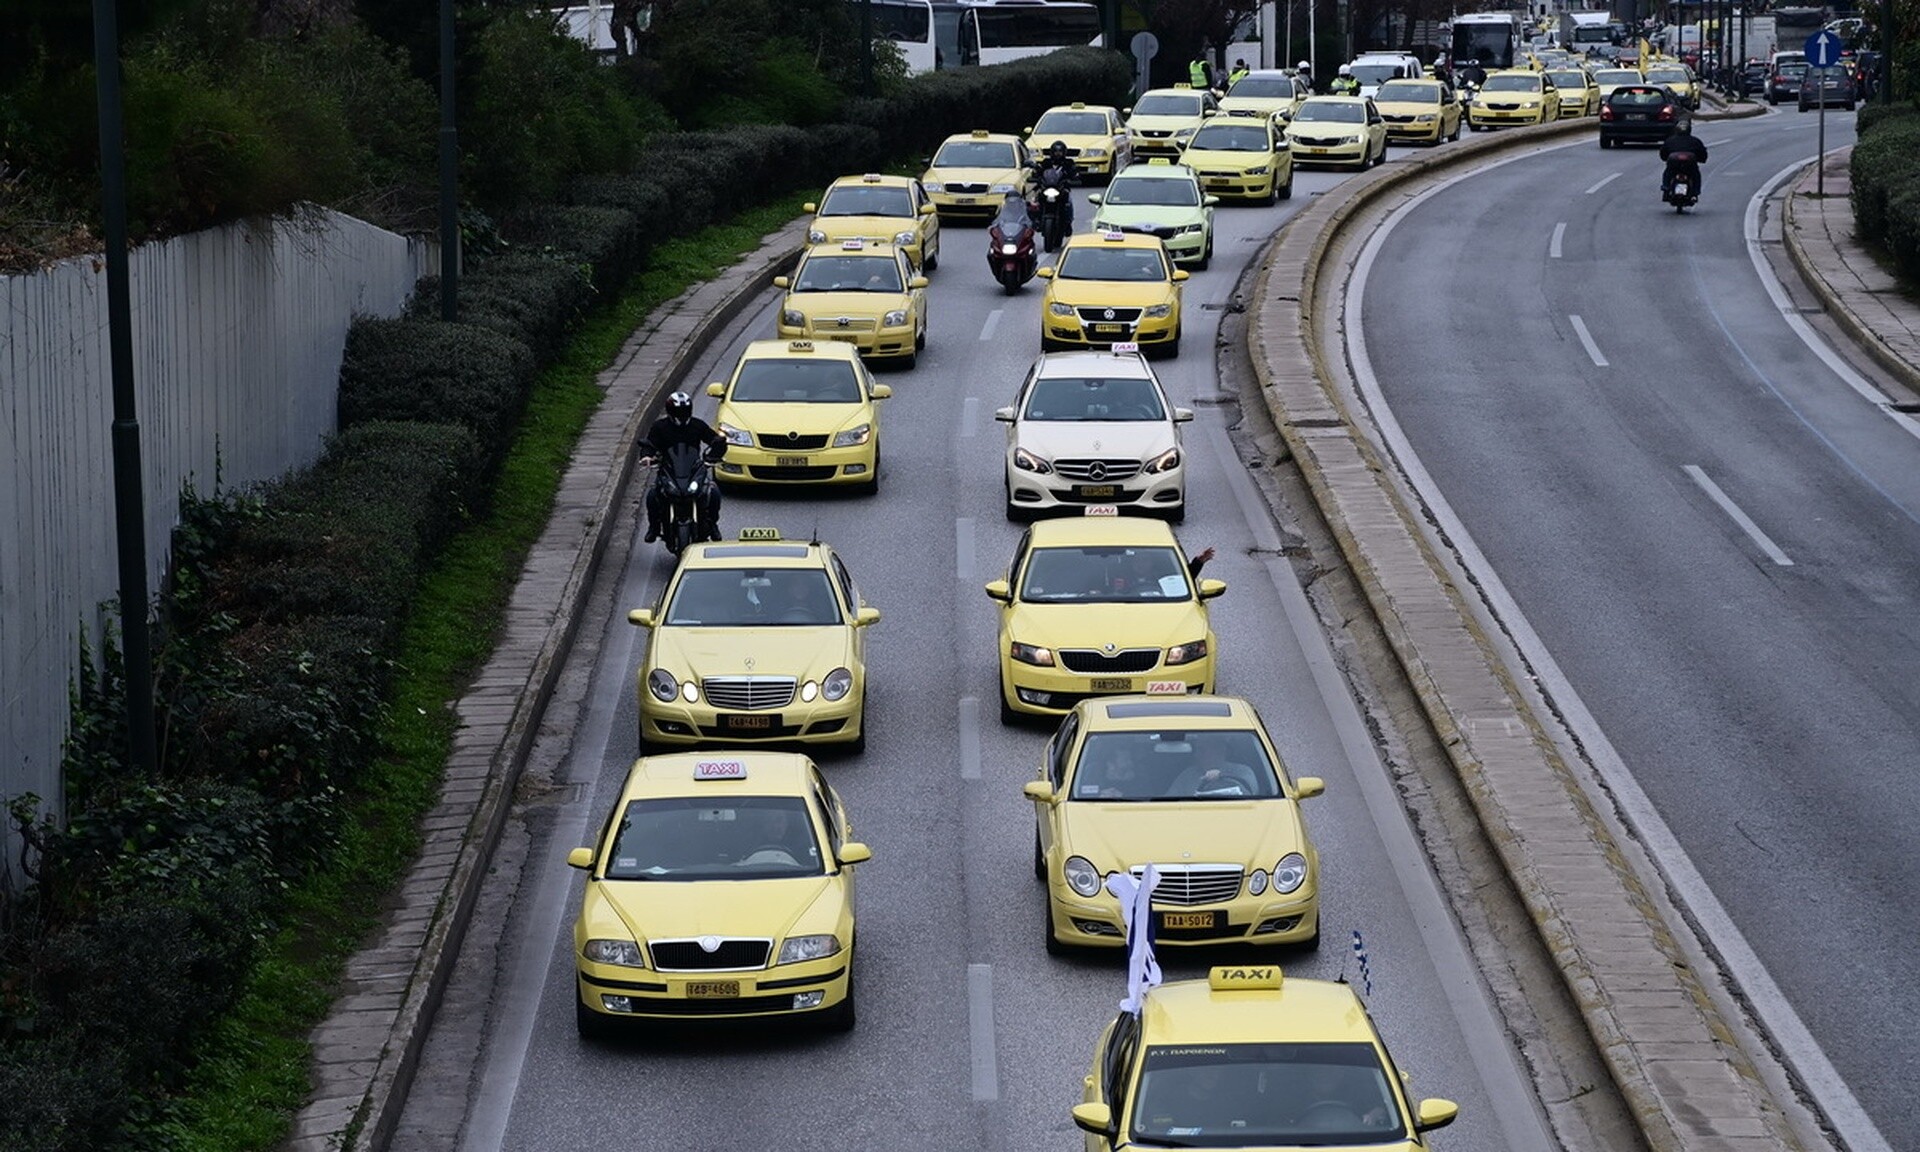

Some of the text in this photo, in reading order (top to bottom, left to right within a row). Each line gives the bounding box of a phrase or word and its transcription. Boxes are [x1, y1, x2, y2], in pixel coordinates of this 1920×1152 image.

[743, 529, 775, 538] TAXI
[1149, 683, 1182, 692] TAXI
[699, 762, 739, 775] TAXI
[1221, 969, 1272, 979] TAXI
